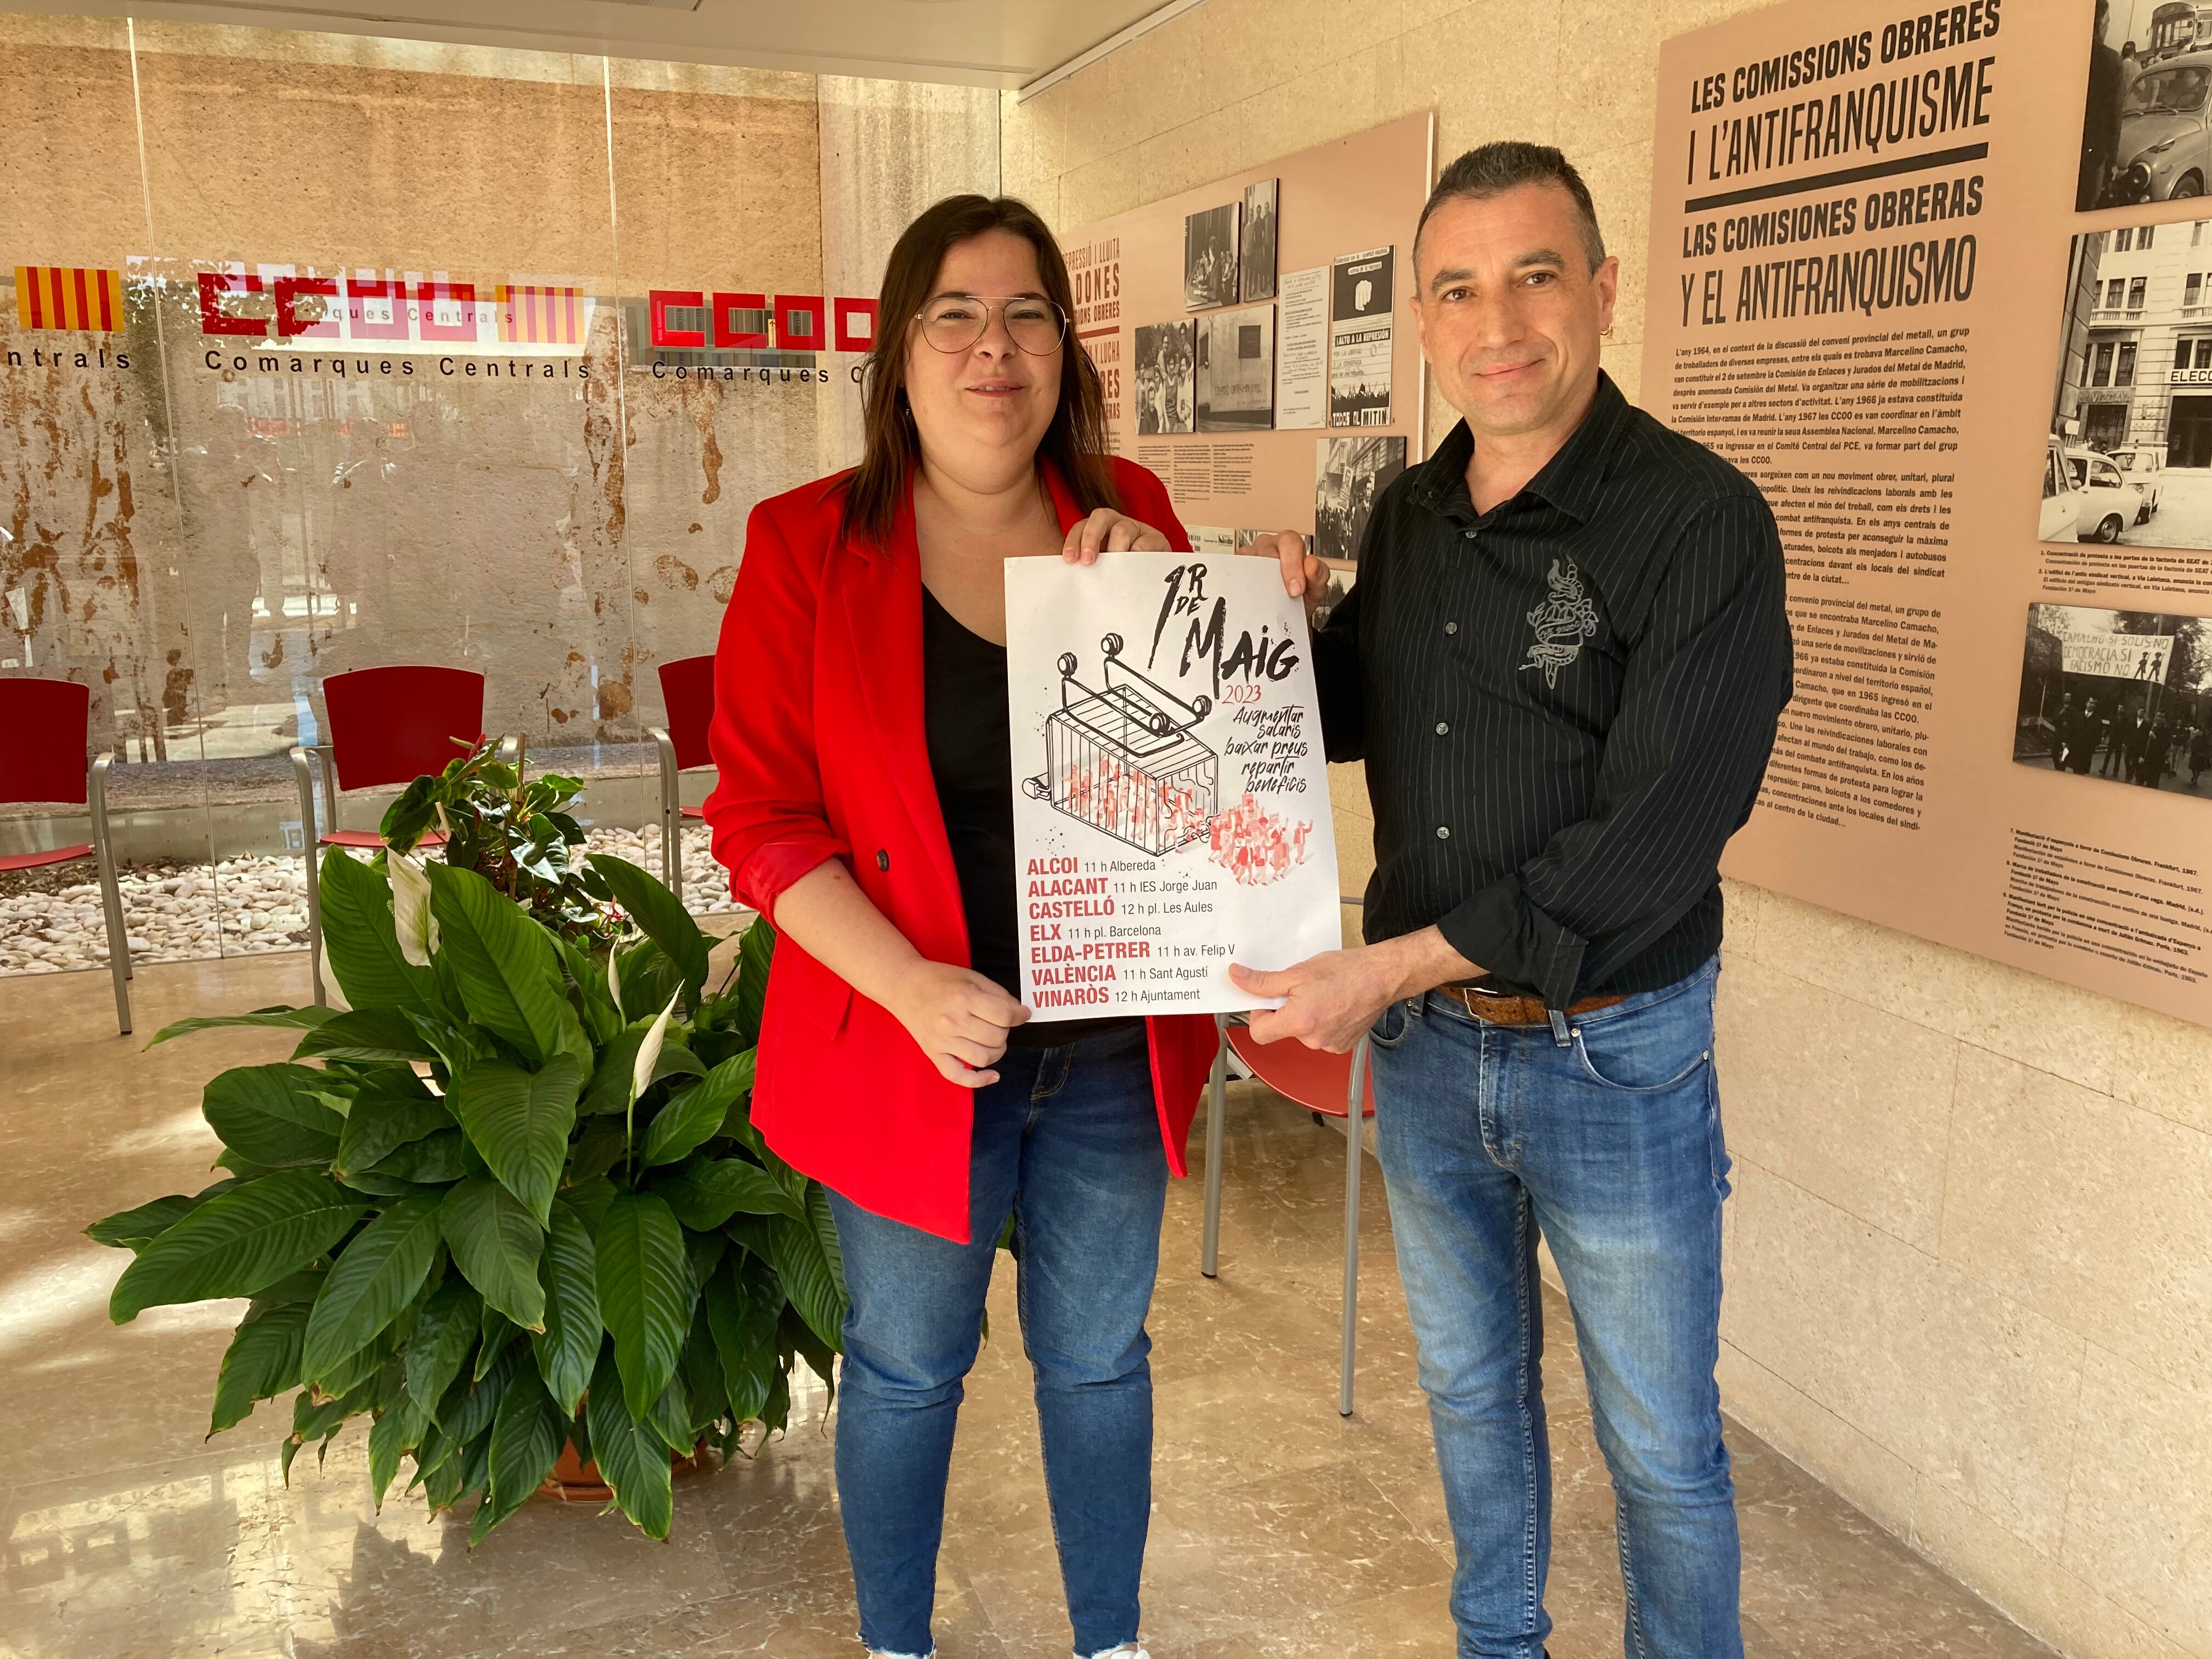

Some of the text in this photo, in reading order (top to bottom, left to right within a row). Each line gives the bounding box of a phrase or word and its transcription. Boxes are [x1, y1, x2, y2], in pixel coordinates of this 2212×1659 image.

[1691, 0, 2001, 113] LES COMISSIONS OBRERES
[1688, 56, 1996, 184] I L'ANTIFRANQUISME
[1683, 176, 1984, 258] LAS COMISIONES OBRERAS
[1100, 238, 1119, 263] LLUITA
[1076, 263, 1119, 305] DONES
[1681, 235, 1977, 326] Y EL ANTIFRANQUISMO
[198, 273, 477, 342] CCOO
[1094, 301, 1119, 321] OBRERES
[649, 290, 879, 352] CCOO
[1351, 334, 1355, 343] A
[1356, 334, 1362, 342] LA
[1675, 348, 1691, 357] L'any
[1692, 346, 1711, 355] 1964,
[1722, 345, 1728, 353] el
[1730, 342, 1754, 352] context
[1756, 342, 1764, 350] de
[1767, 342, 1773, 350] la
[1775, 338, 1807, 349] discussió
[1808, 337, 1820, 347] del
[1821, 335, 1849, 346] conveni
[1852, 332, 1889, 345] provincial
[1891, 331, 1903, 341] del
[1906, 329, 1934, 340] metall,
[1949, 328, 1970, 338] grup
[7, 348, 130, 369] ntrals
[1101, 341, 1120, 363] LUCHA
[1683, 359, 1718, 369] treballadors
[1728, 358, 1754, 366] diverses
[1756, 356, 1790, 366] empreses,
[1791, 354, 1809, 362] entre
[1811, 353, 1821, 362] els
[1822, 351, 1842, 362] quals
[1854, 349, 1882, 359] trobava
[1884, 346, 1924, 357] Marcelino
[1926, 343, 1967, 354] Camacho,
[205, 351, 589, 379] Comarques Centrals
[652, 360, 828, 385] Comarques
[1671, 415, 1677, 423] la
[1678, 414, 1705, 423] Comisión
[1706, 414, 1741, 422] Inter-ramas
[1742, 413, 1751, 421] de
[1752, 413, 1776, 421] Madrid.
[1778, 413, 1797, 422] L'any
[1798, 412, 1817, 421] 1967
[1818, 412, 1829, 420] les
[1831, 411, 1852, 420] CCOO
[1880, 409, 1918, 419] coordinar
[1932, 408, 1961, 418] l'àmbit
[1174, 596, 1200, 616] DE
[2063, 646, 2118, 662] DEMOCRACIA
[2114, 663, 2130, 676] NO
[1222, 685, 1261, 704] 2023
[1795, 680, 1829, 694] Camacho,
[1831, 687, 1844, 696] que
[1858, 690, 1878, 701] 1965
[1881, 693, 1909, 706] ingresó
[1925, 702, 1932, 710] el
[1233, 704, 1305, 727] Augmentar
[1257, 721, 1301, 739] salaris
[1224, 737, 1308, 759] baixar preus
[1242, 755, 1300, 778] repartir
[1245, 775, 1307, 794] beneficis
[1027, 857, 1155, 875] ALCOI 11 h Albereda
[1028, 877, 1217, 897] ALACANT 11 h IES Jorge Juan
[1029, 894, 1212, 919] CASTELLÓ 12 h pl. Les Aules
[1030, 923, 1161, 941] ELX 11 h pl. Barcelona
[1031, 941, 1234, 963] ELDA-PETRER 11 h av. Felip V
[1031, 963, 1207, 985] VALÈNCIA 11 h Sant Agustí
[1032, 983, 1200, 1008] VINARÒS 12 h Ajuntament
